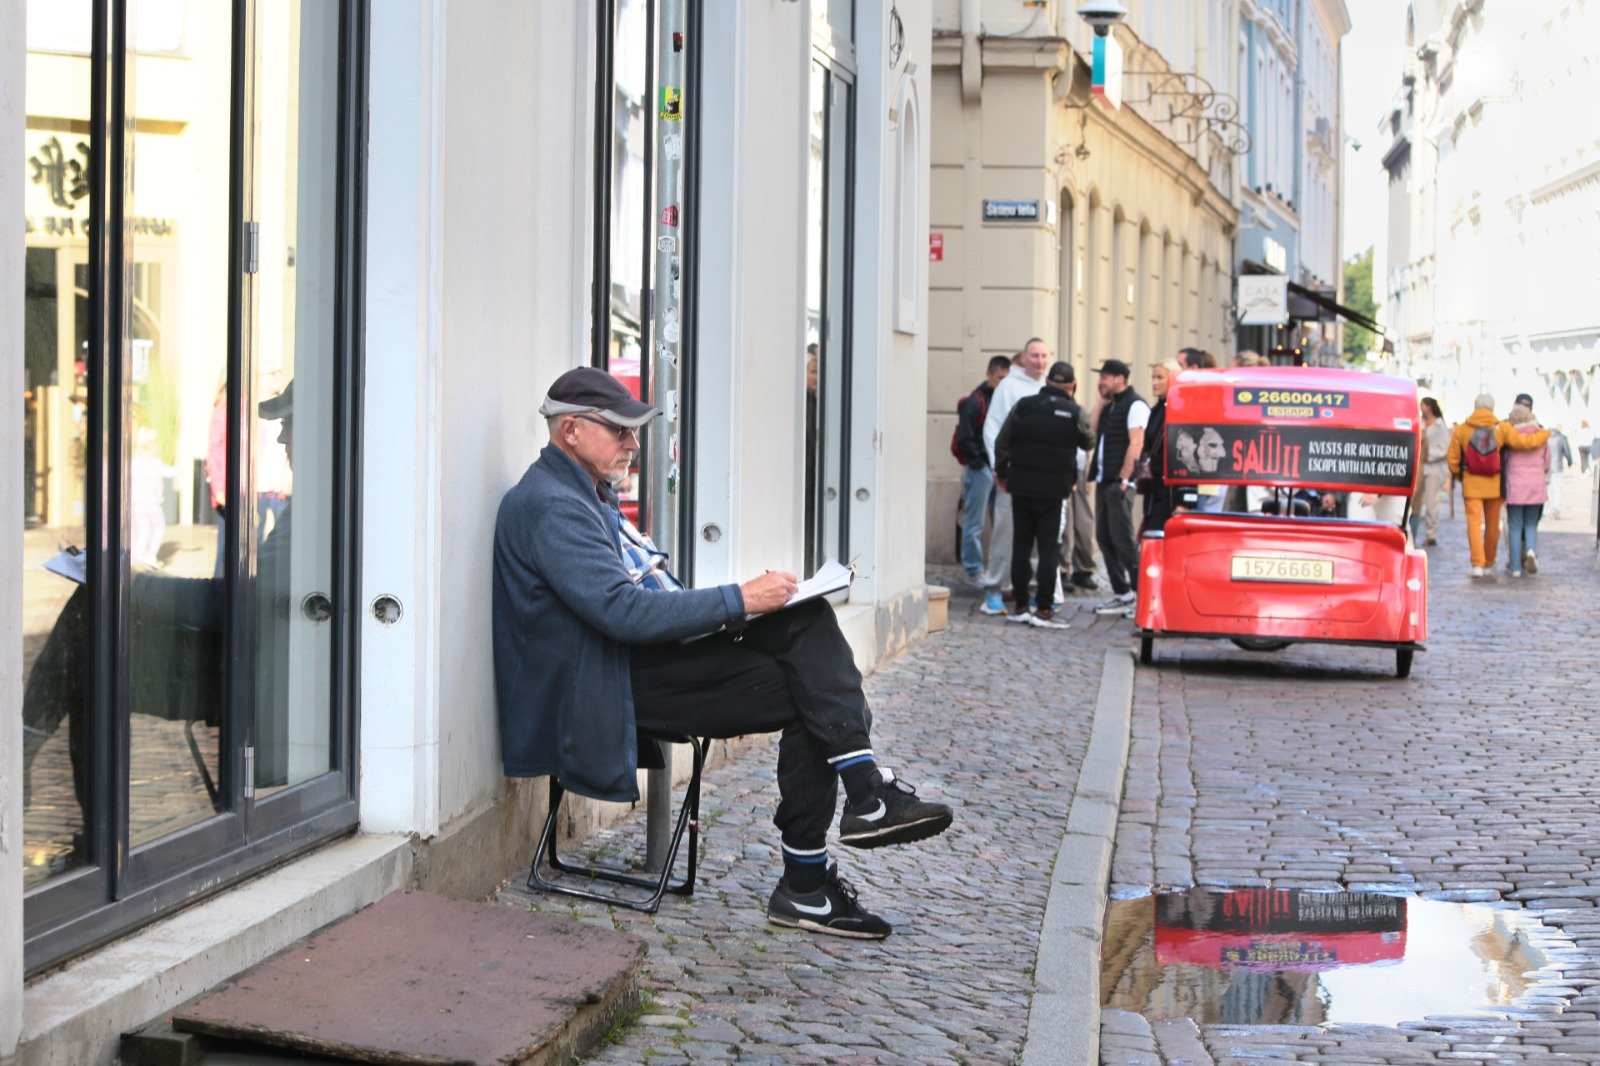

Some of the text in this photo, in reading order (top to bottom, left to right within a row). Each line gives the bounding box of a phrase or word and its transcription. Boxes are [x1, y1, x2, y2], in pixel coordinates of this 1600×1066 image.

[1258, 391, 1345, 406] 26600417
[1232, 433, 1281, 474] SAW
[1308, 440, 1409, 461] KVESTS AR AKTIERIEM
[1308, 457, 1407, 478] ESCAPE WITH LIVE ACTORS
[1245, 560, 1323, 578] 1576669
